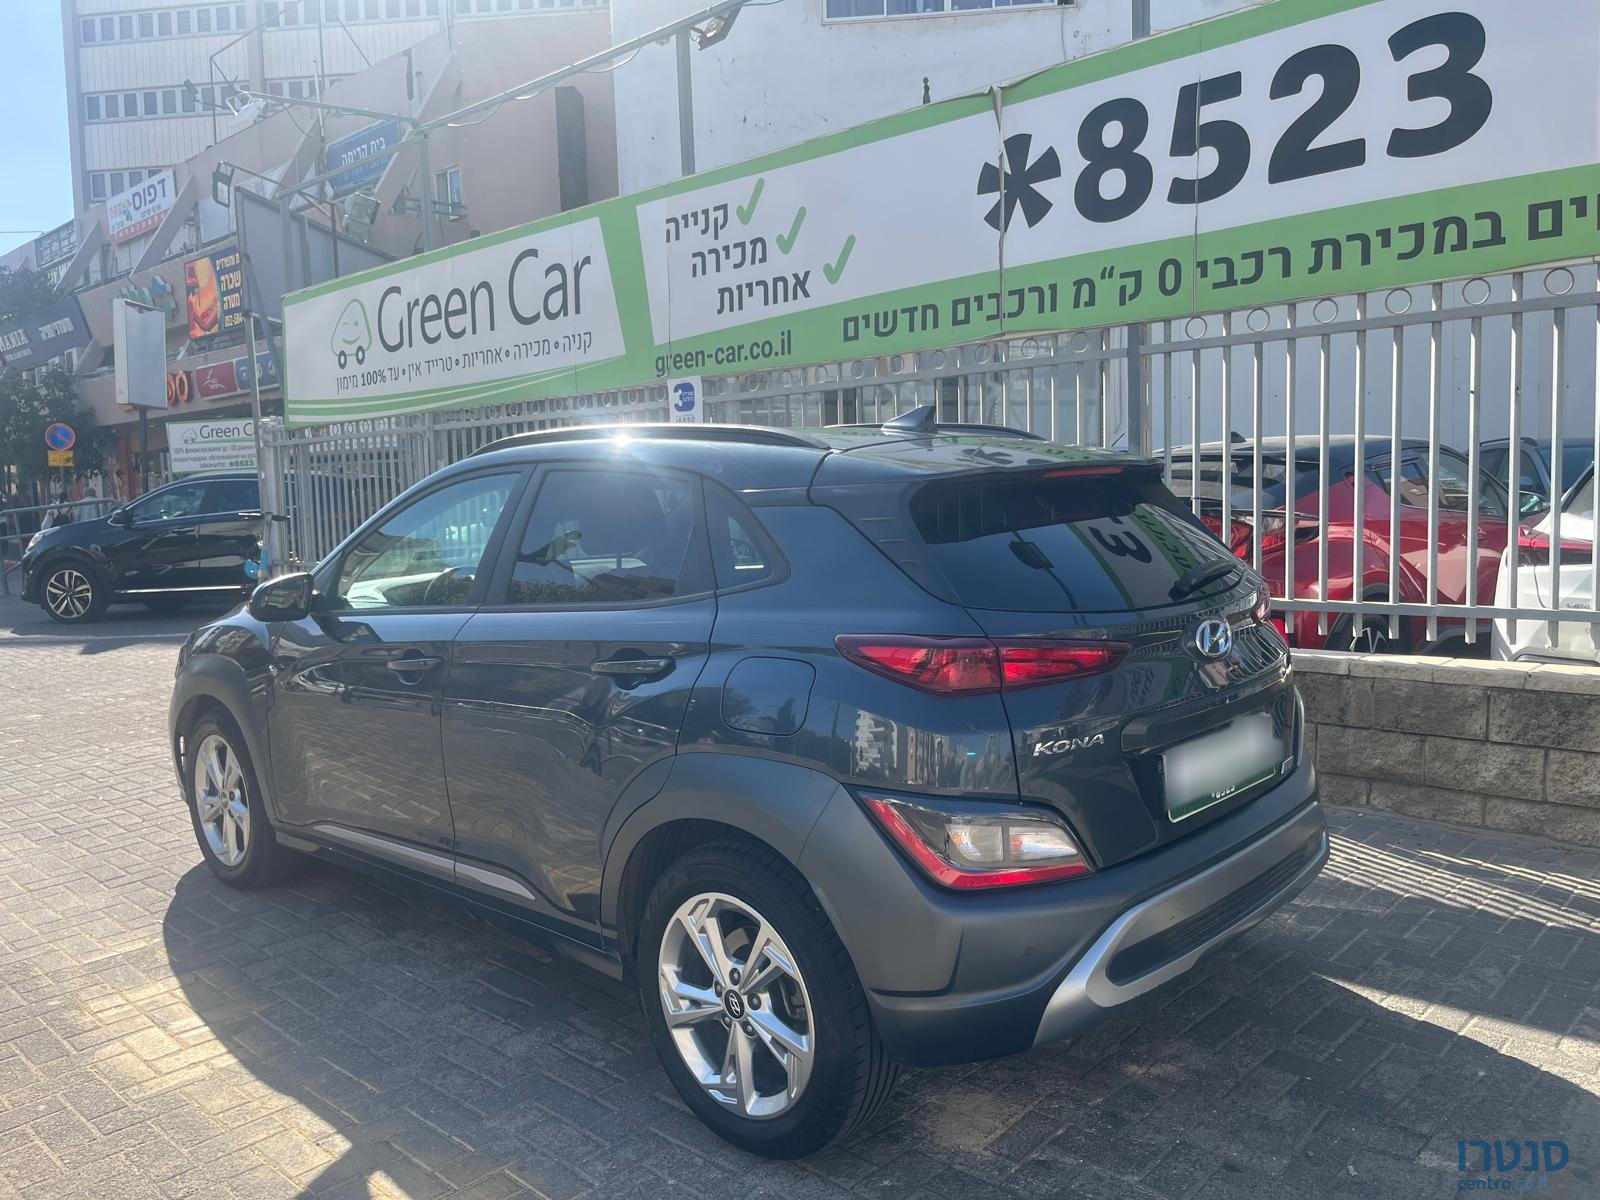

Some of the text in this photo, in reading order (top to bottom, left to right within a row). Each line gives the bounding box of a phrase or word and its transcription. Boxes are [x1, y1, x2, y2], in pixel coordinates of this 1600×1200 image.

[132, 177, 167, 211] דפוס
[665, 203, 728, 243] קנייה
[1528, 193, 1600, 241] ים
[692, 237, 767, 278] מכירה
[1307, 211, 1506, 275] במכירת
[220, 270, 241, 292] שכרה
[1158, 258, 1182, 296] 0
[1196, 246, 1292, 290] רכבי
[377, 248, 591, 353] Green Car
[717, 270, 811, 315] אחריות
[951, 283, 1057, 326] ורכבים
[843, 303, 939, 342] חדשים
[336, 331, 592, 395] קניה מכירה אחריות טרייד אין עד 100% מימון
[655, 329, 792, 378] green-car.co.il
[200, 422, 255, 439] Green C
[1032, 733, 1105, 757] KONA
